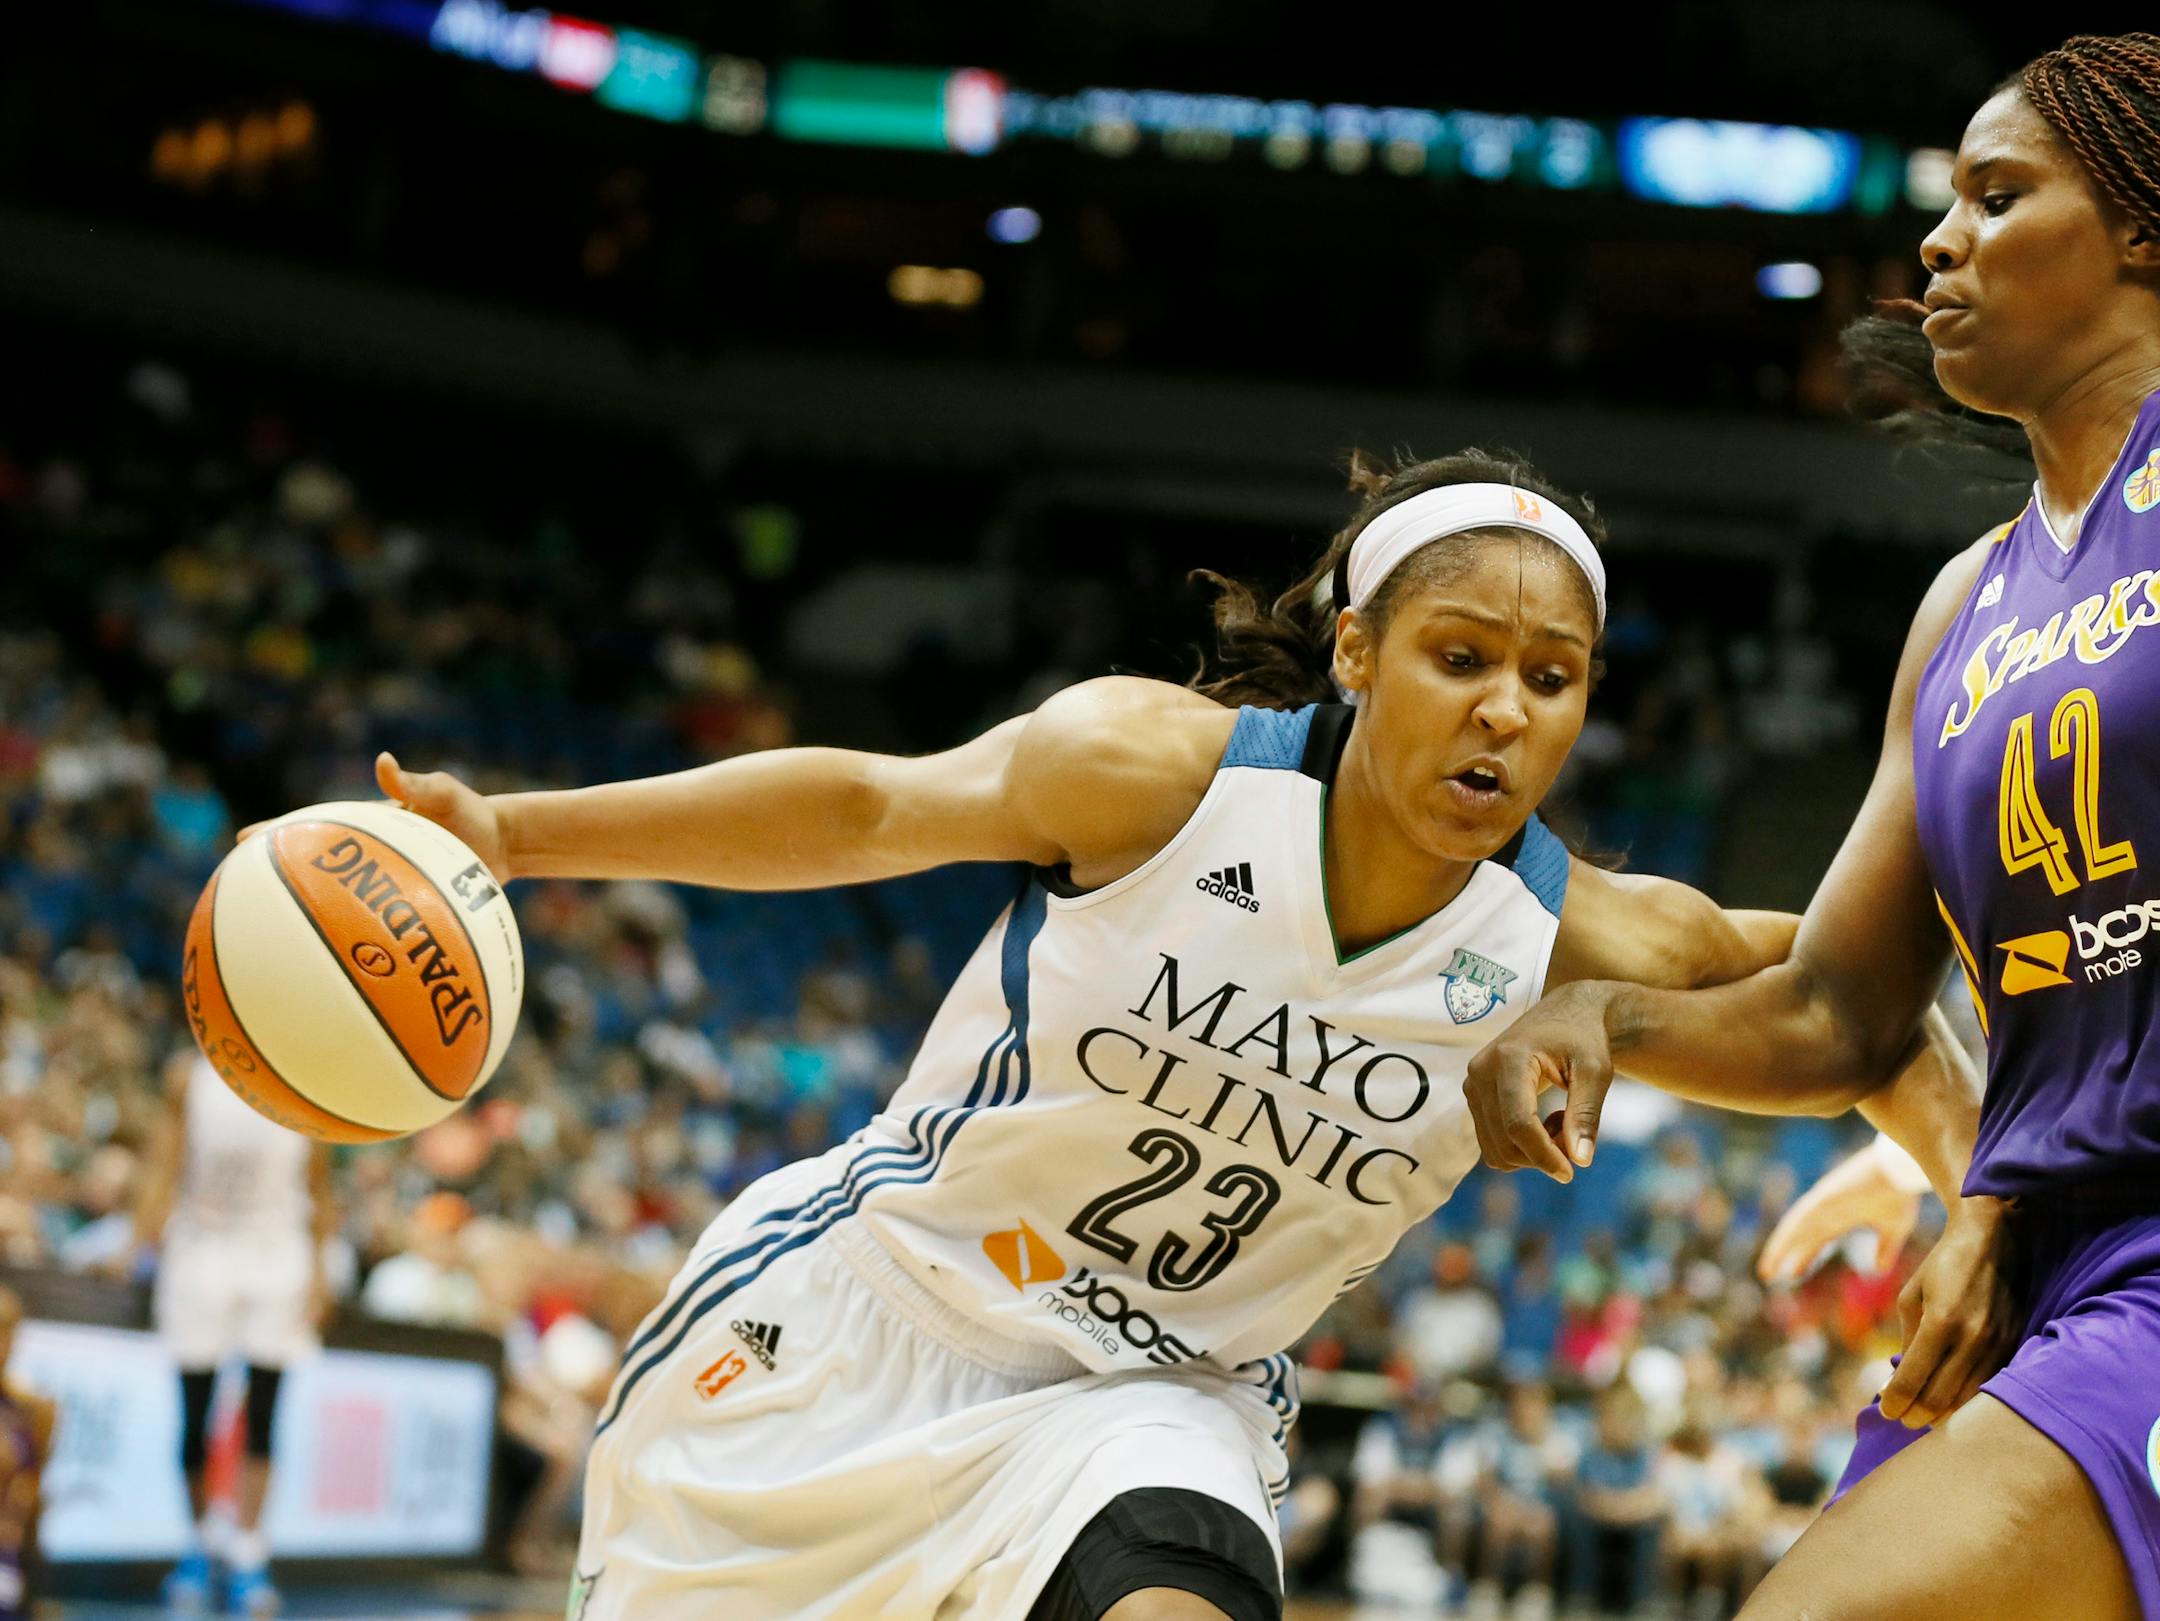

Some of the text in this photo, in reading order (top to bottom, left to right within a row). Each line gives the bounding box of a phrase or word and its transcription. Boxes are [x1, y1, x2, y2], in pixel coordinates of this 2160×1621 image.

[1999, 687, 2138, 897] 42
[311, 836, 483, 1047] SPALDING
[1195, 877, 1260, 913] adidas
[1077, 1027, 1420, 1206] CLINIC
[1127, 952, 1430, 1123] MAYO
[1065, 1128, 1282, 1292] 23
[1038, 1291, 1120, 1356] mobile
[1059, 1267, 1210, 1365] boos
